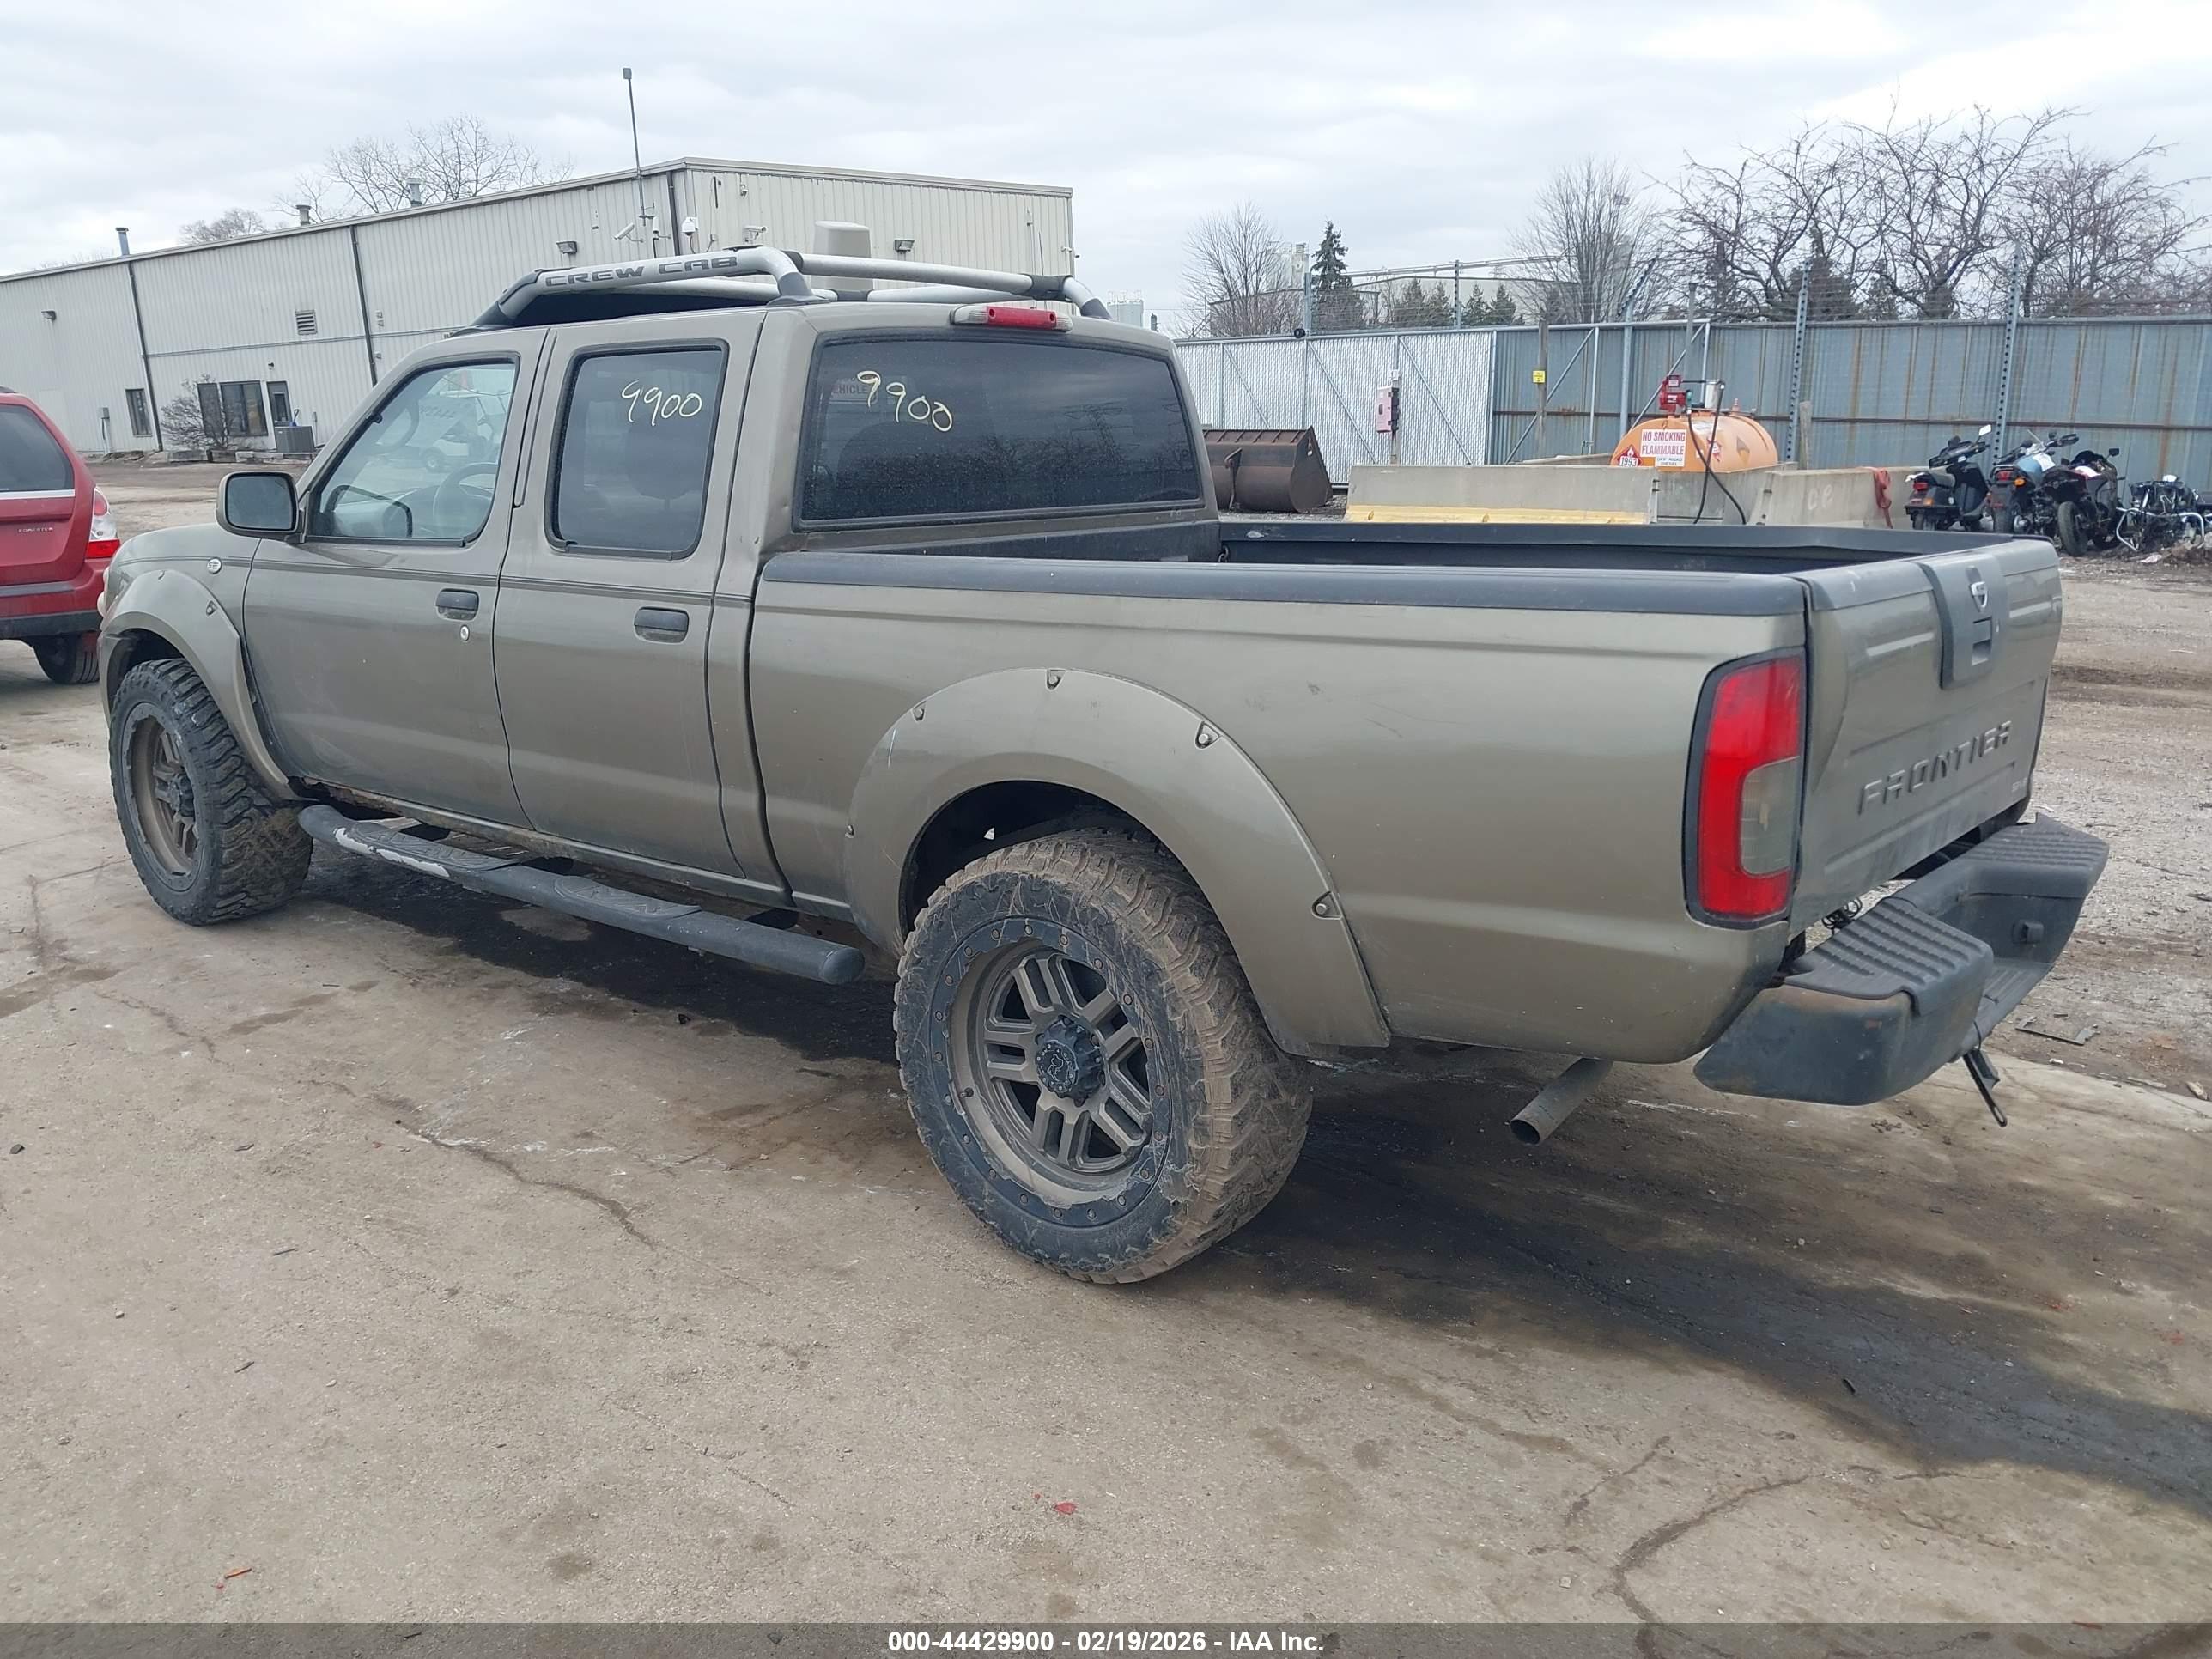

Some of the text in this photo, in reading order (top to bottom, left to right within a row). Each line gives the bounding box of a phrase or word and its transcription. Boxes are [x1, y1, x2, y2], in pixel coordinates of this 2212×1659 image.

[544, 256, 738, 287] CREW CAB
[830, 384, 869, 394] EHICLE
[621, 378, 702, 427] 9900
[856, 369, 953, 432] 9900
[1642, 431, 1686, 442] NO SMOKING
[1641, 445, 1685, 455] FLAMMABLE
[1620, 457, 1637, 467] 1993
[1857, 720, 2013, 817] FRONTIER
